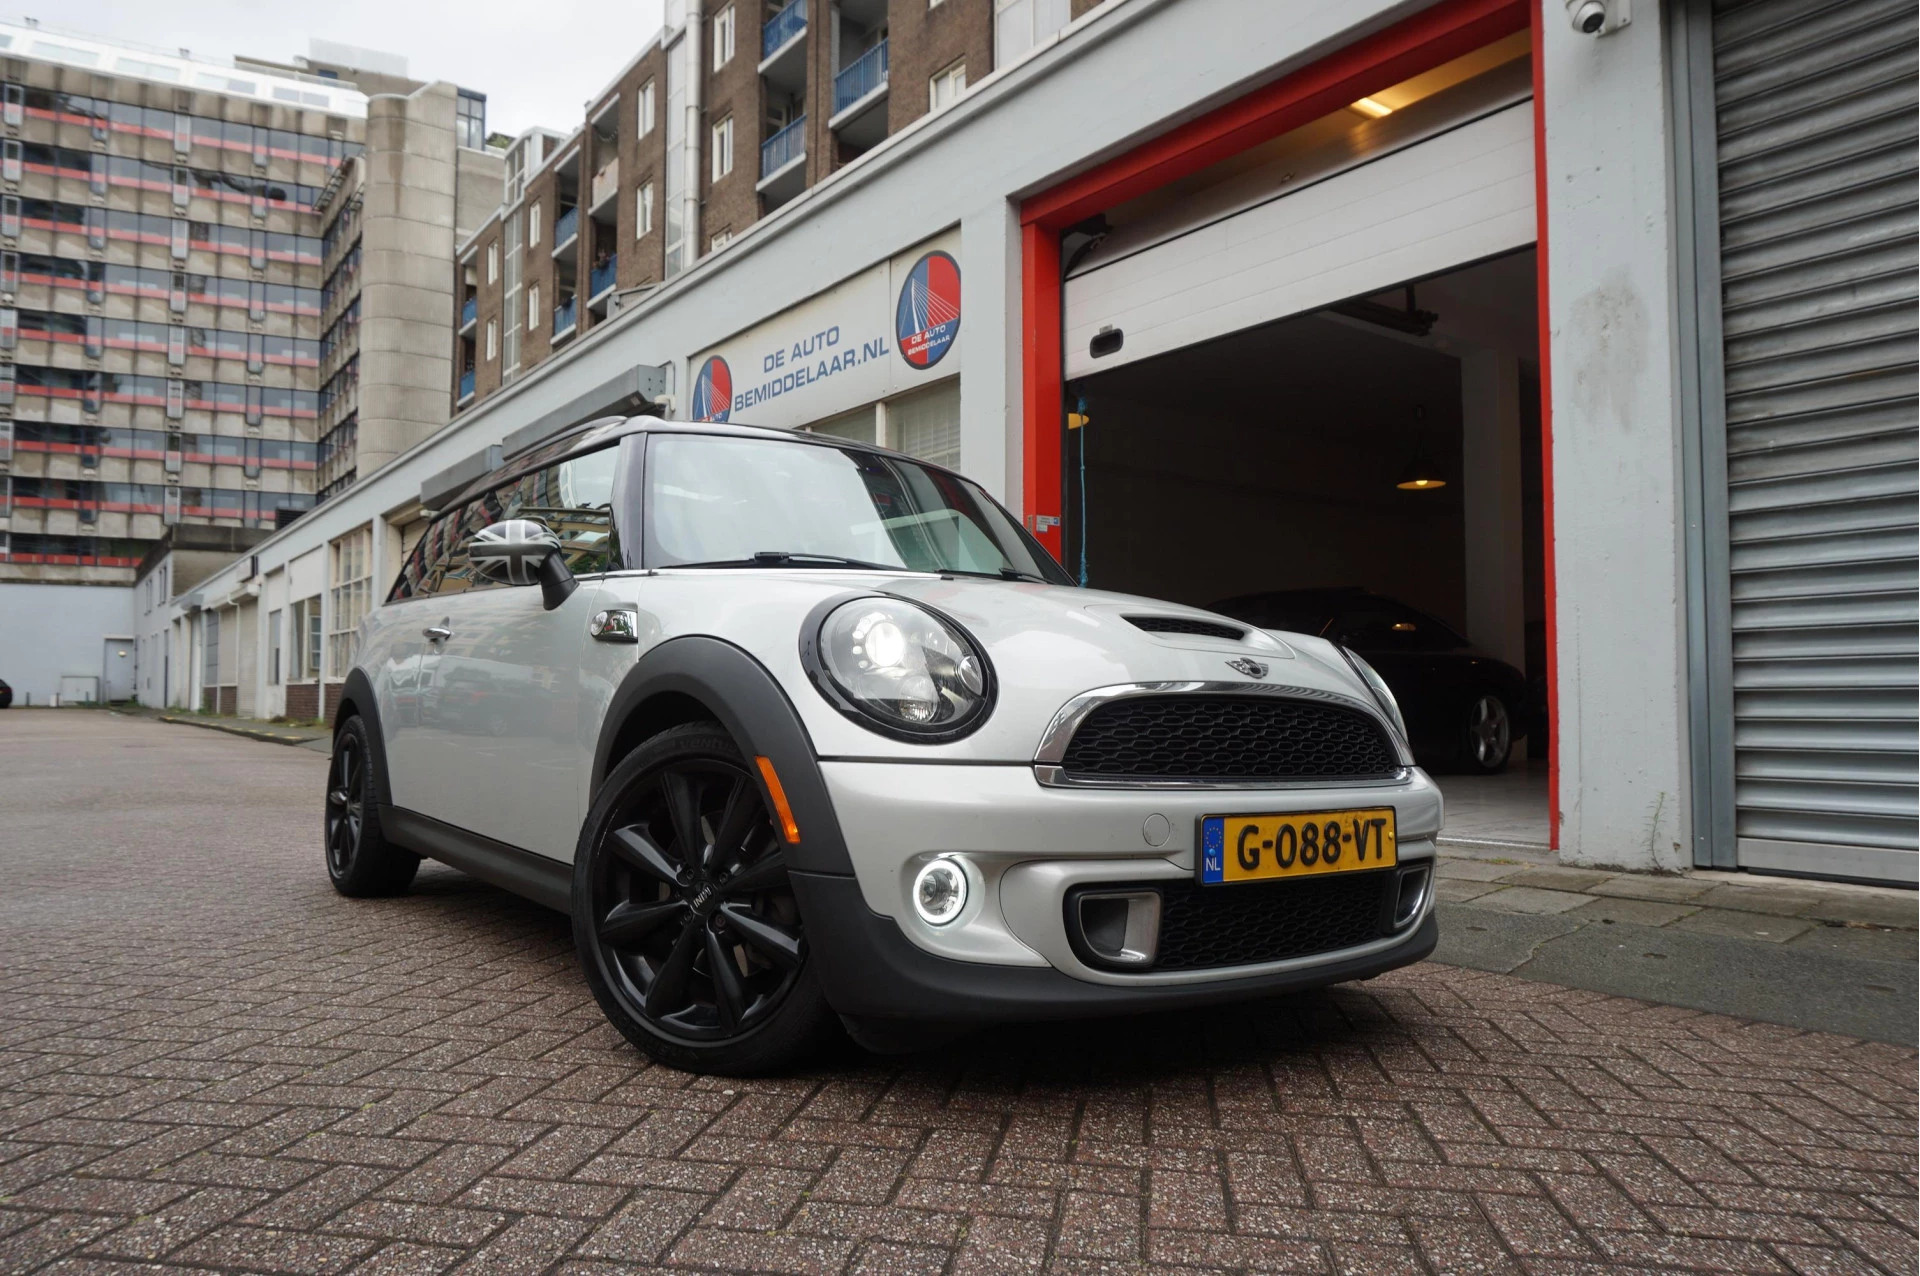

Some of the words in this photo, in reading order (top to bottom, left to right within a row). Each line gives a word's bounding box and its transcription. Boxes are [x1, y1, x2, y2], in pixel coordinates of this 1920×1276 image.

[763, 351, 785, 373] DE
[791, 325, 840, 362] AUTO
[911, 333, 922, 345] DE
[924, 324, 946, 340] AUTO
[734, 336, 890, 412] BEMIDDELAAR.NL
[1237, 818, 1387, 871] G-088-VT
[1205, 857, 1221, 872] NL
[693, 886, 712, 908] MINI
